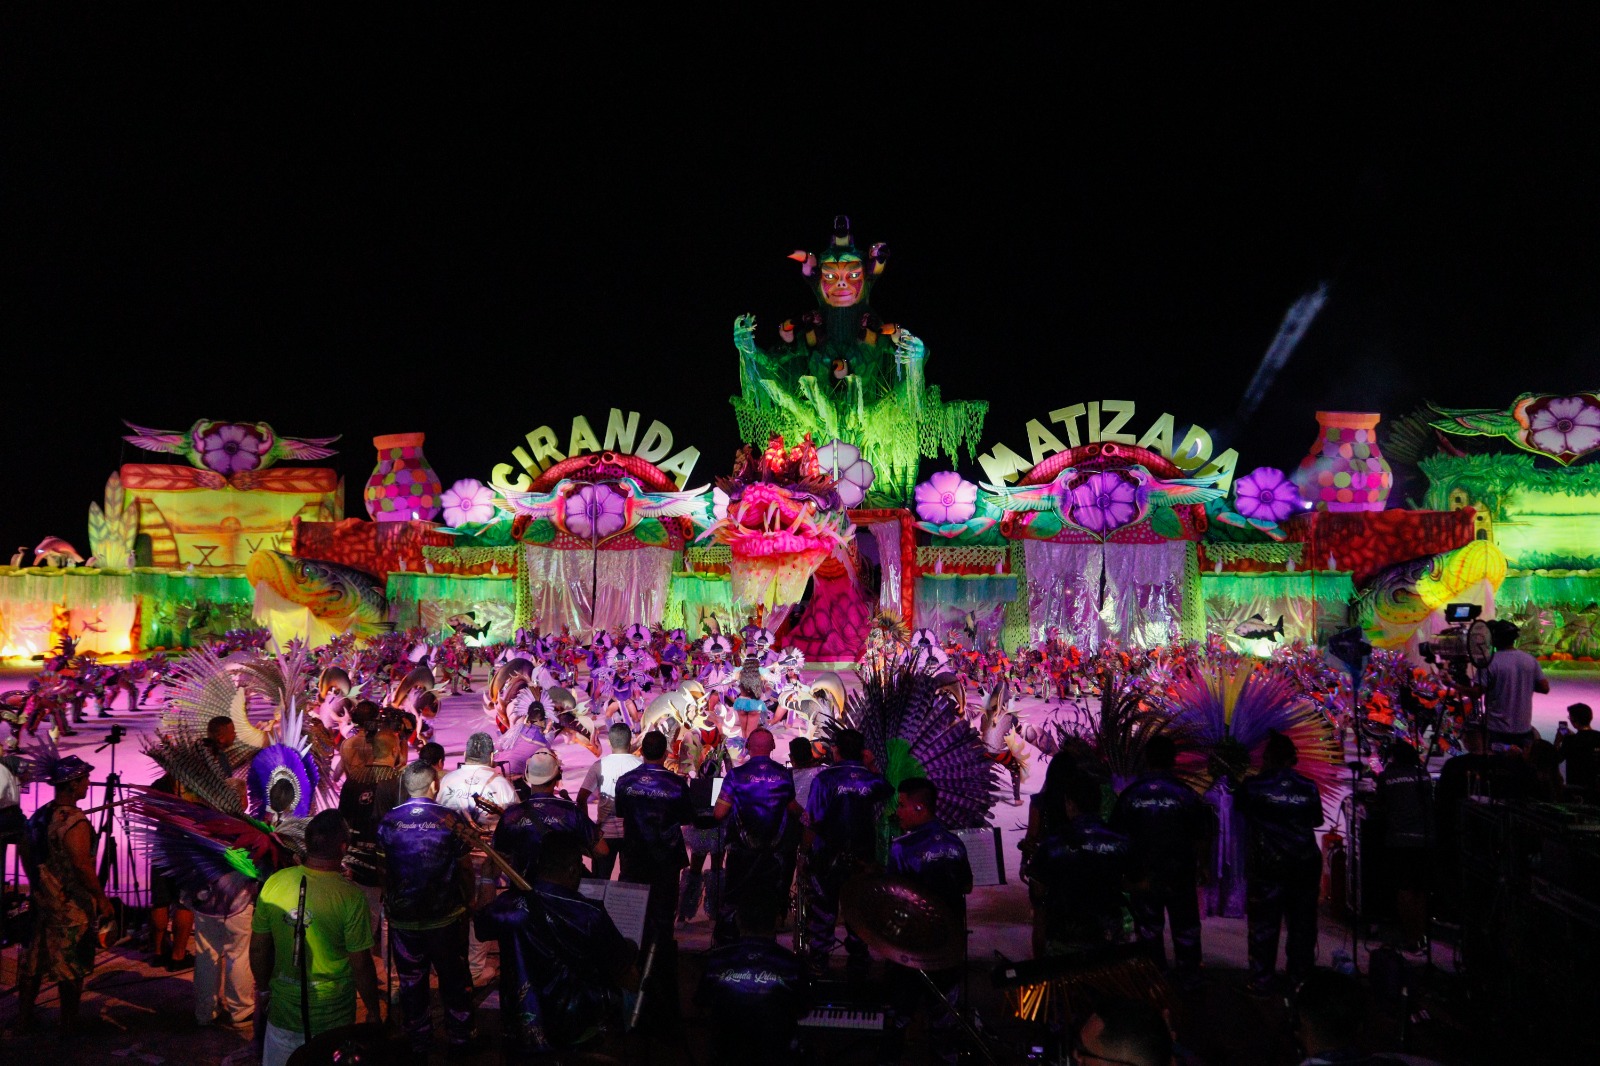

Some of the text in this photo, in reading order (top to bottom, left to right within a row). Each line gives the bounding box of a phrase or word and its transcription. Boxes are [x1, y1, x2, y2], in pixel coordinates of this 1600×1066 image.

[491, 407, 701, 492] CIRANDA
[977, 399, 1240, 499] MATIZADA
[725, 968, 752, 983] Banda
